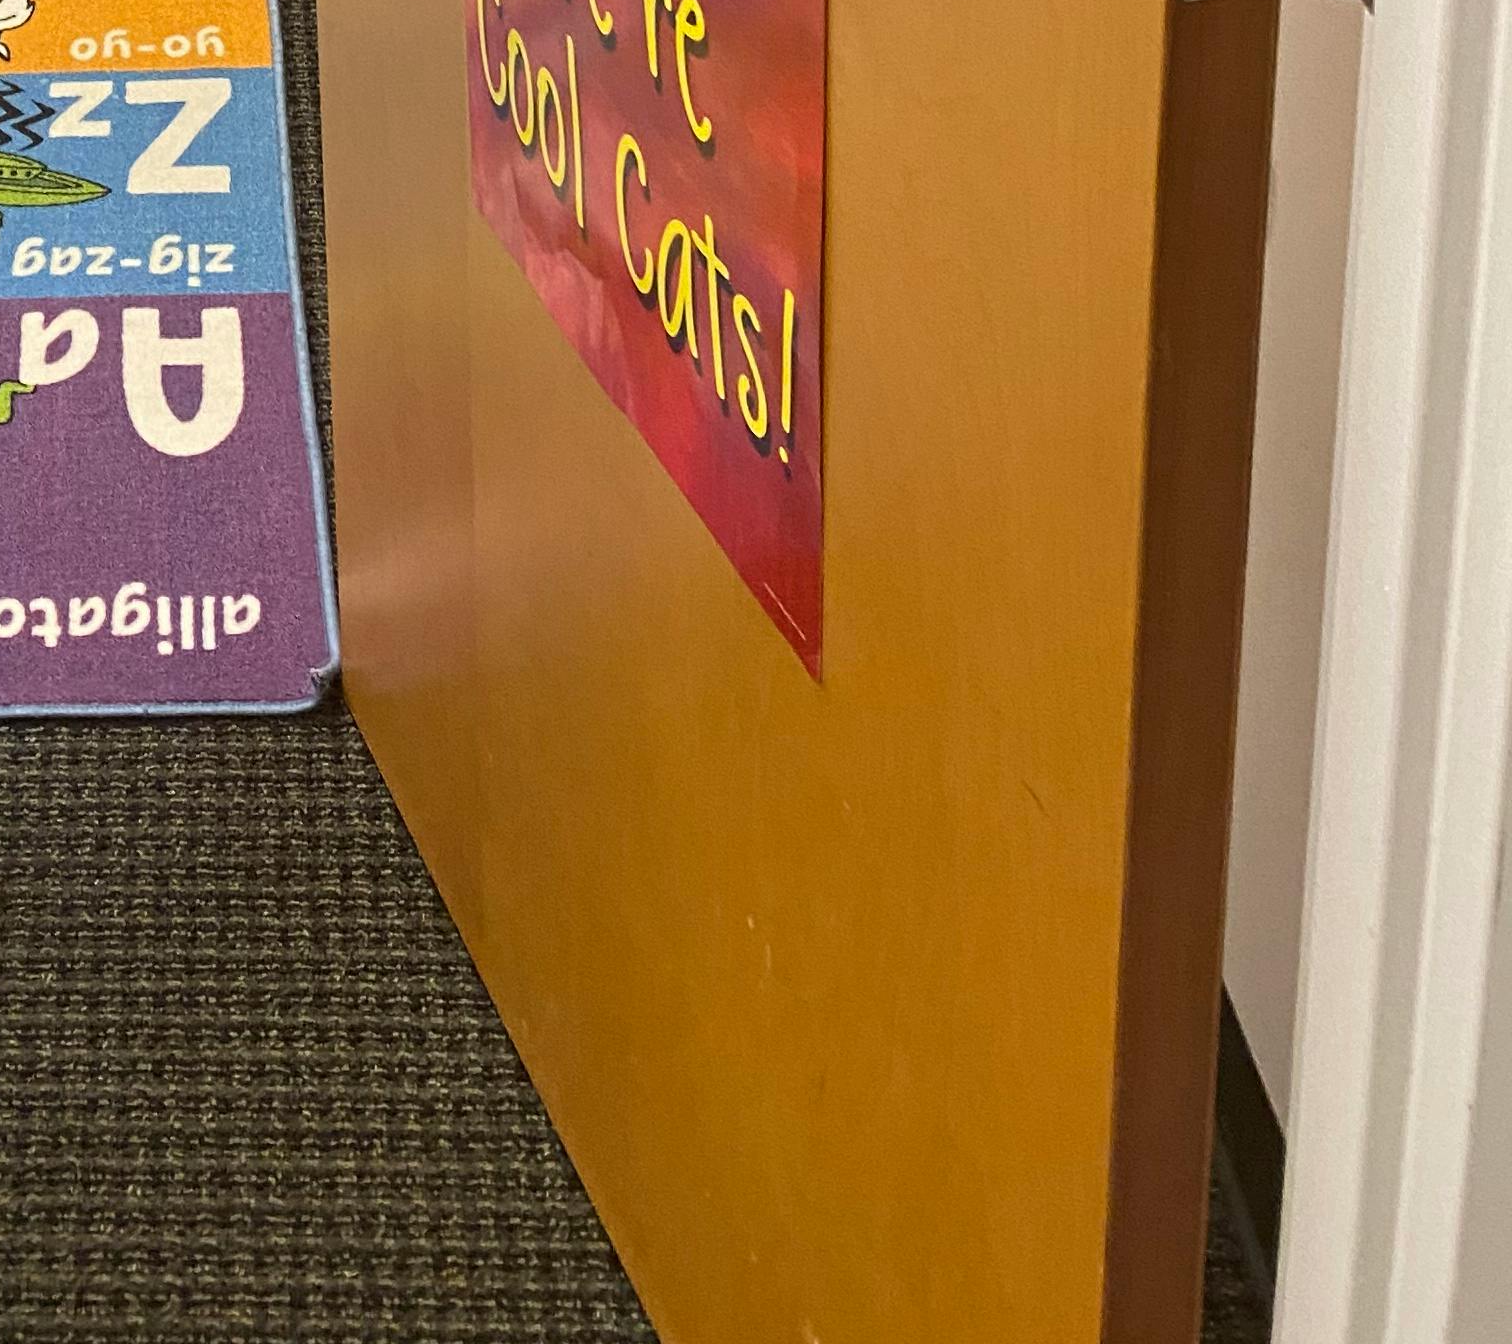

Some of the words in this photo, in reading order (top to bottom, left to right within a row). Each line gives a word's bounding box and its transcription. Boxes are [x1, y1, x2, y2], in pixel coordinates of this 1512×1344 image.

[69, 26, 226, 61] yo-yo
[49, 78, 231, 195] Zz
[11, 234, 236, 287] zig-zag
[614, 132, 794, 466] Cats!
[18, 307, 242, 456] Aa
